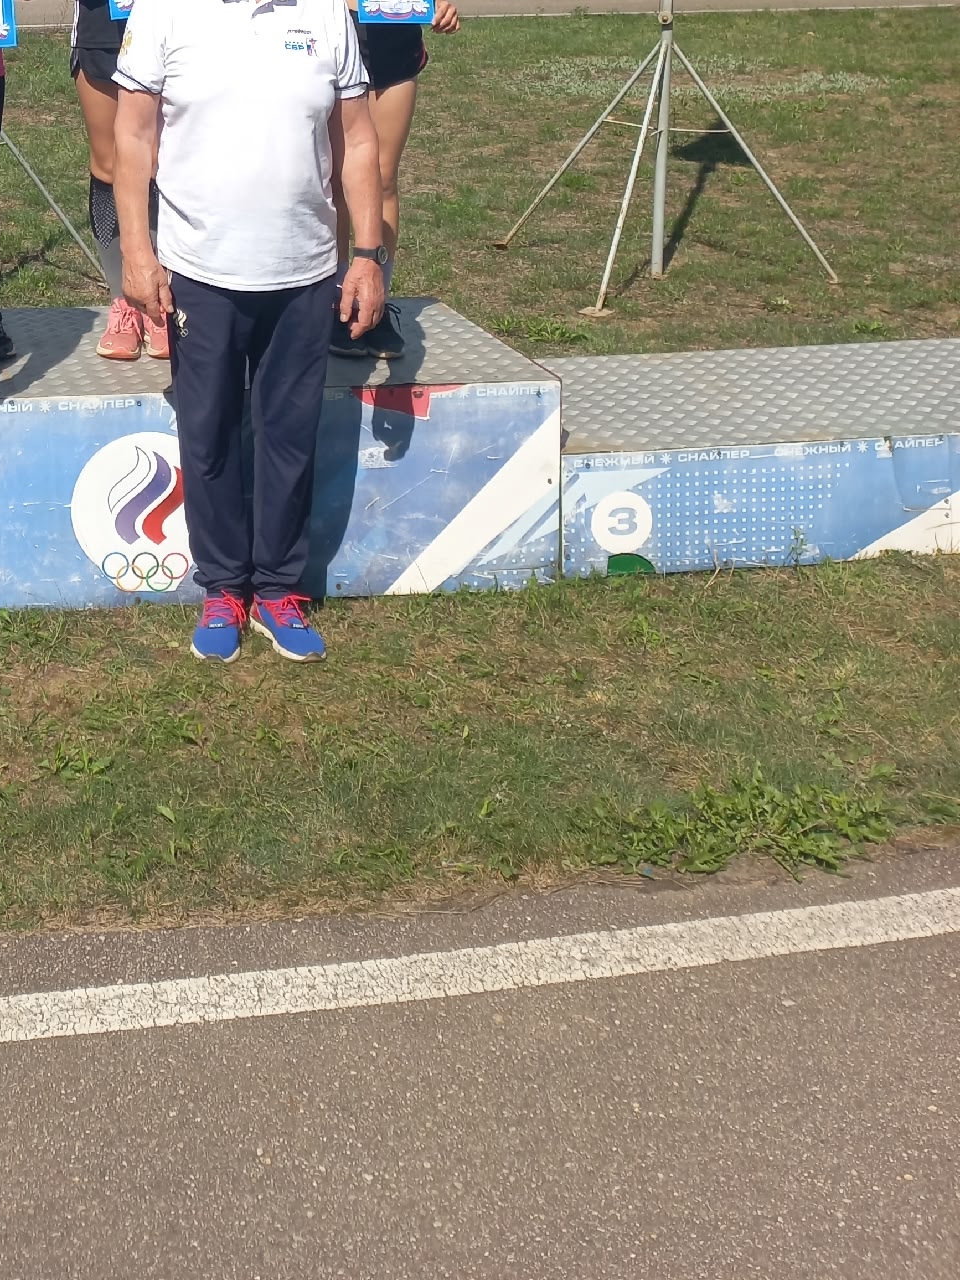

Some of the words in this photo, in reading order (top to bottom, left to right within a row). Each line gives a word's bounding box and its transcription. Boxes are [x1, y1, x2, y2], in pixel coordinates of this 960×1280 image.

[476, 386, 549, 398] СНАЙПЕР
[58, 399, 137, 411] СНАЙПЕР
[574, 454, 655, 468] СНЕЖНЫЙ
[677, 449, 751, 463] СНАЙПЕР
[874, 437, 945, 451] САЙПЕР
[607, 507, 638, 536] 3
